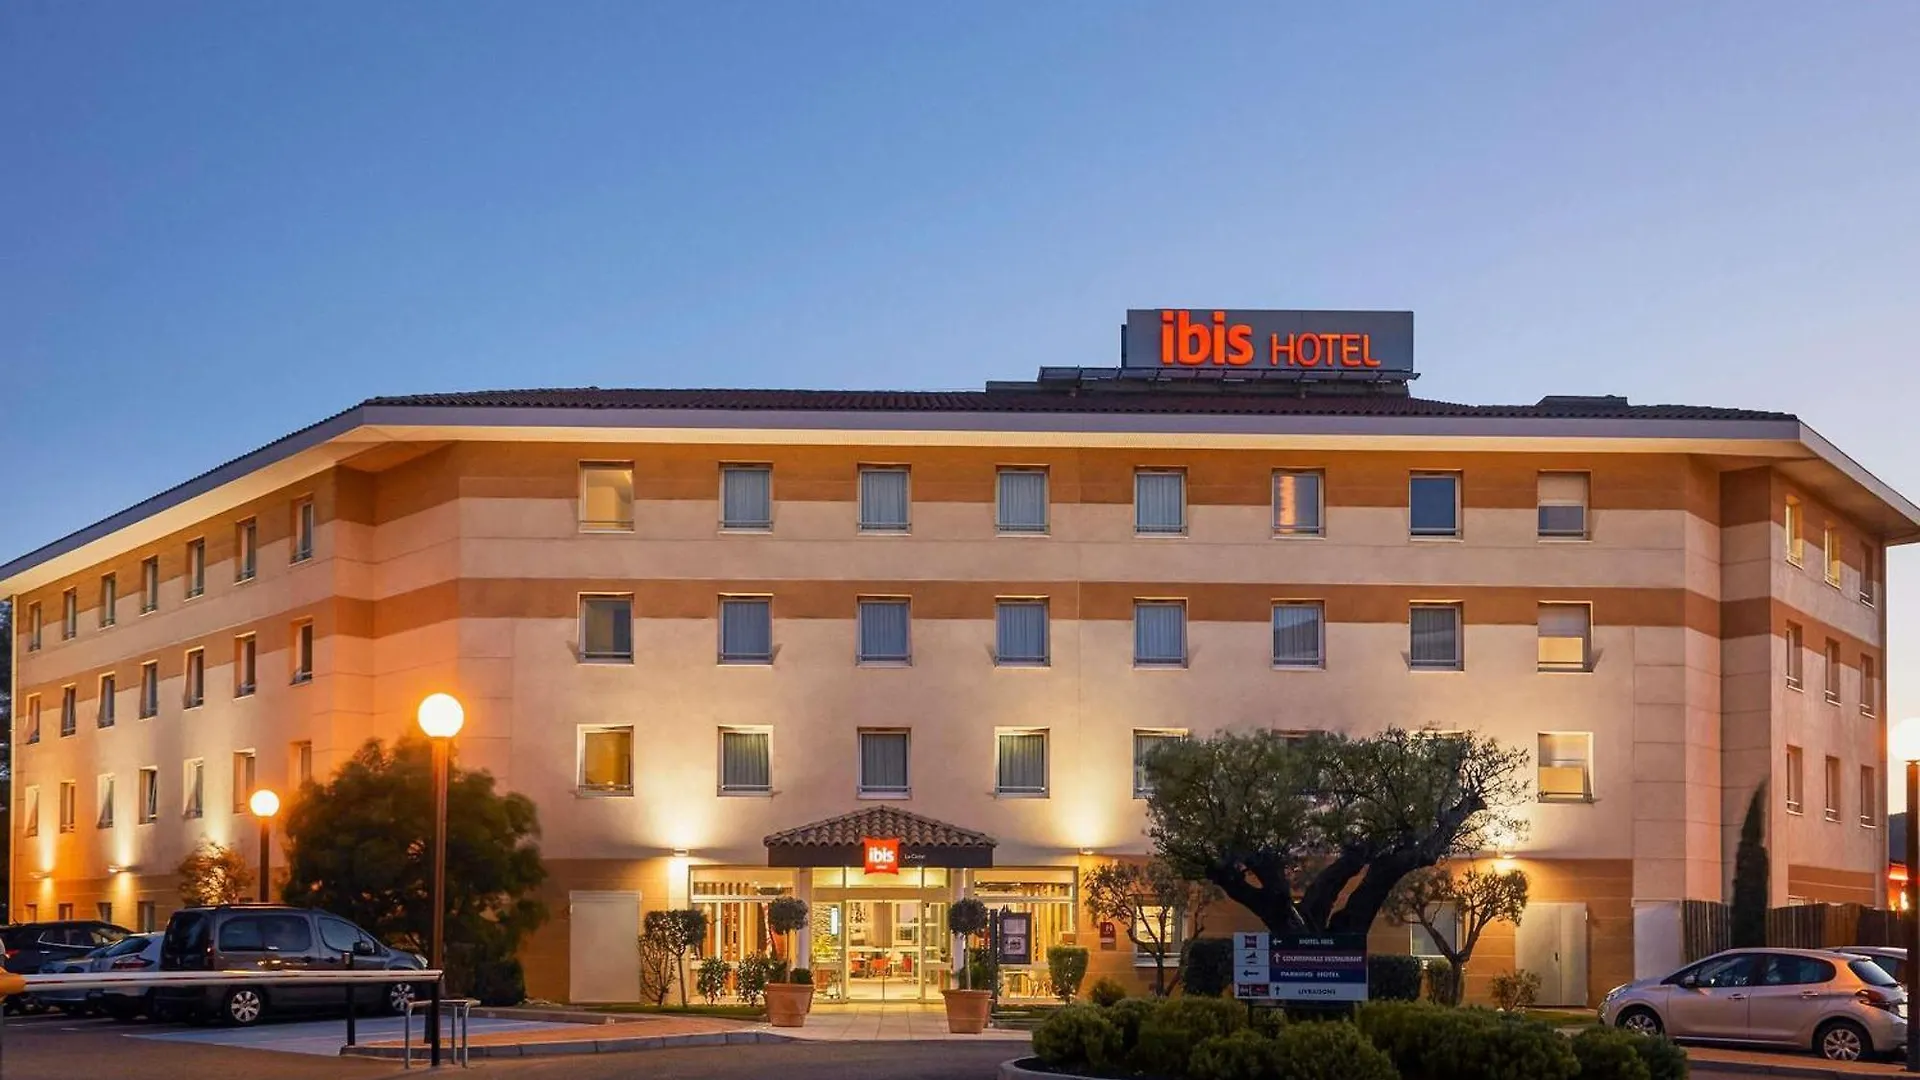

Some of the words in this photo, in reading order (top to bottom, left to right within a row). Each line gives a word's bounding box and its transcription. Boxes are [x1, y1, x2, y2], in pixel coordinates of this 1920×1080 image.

[1161, 310, 1254, 365] ibis
[1271, 333, 1381, 367] HOTEL
[868, 847, 895, 863] ibis
